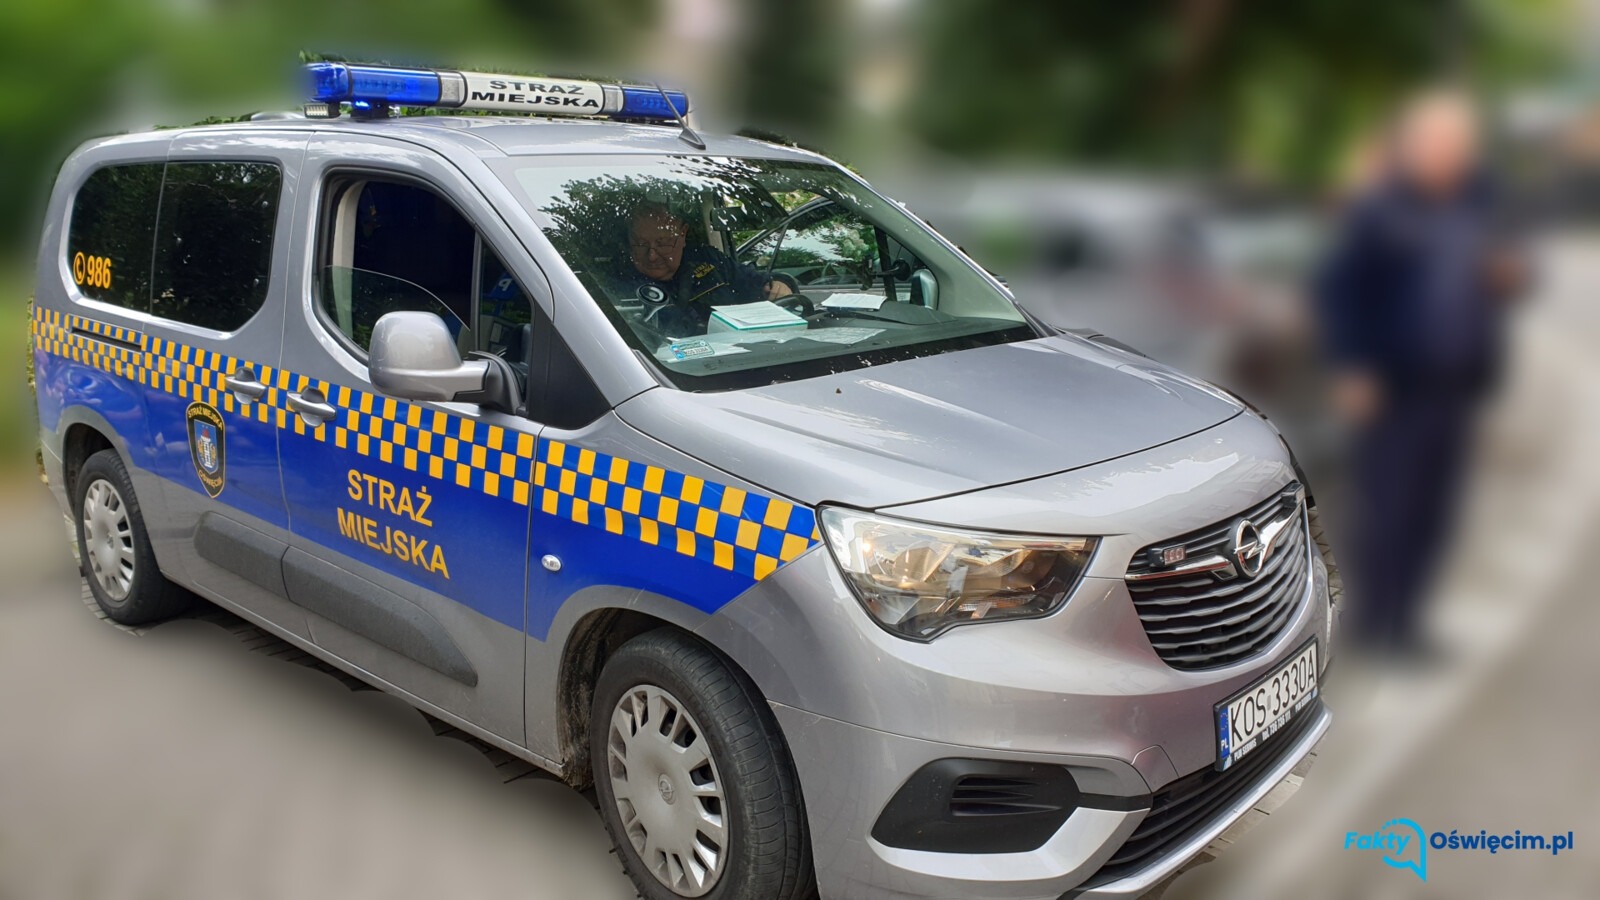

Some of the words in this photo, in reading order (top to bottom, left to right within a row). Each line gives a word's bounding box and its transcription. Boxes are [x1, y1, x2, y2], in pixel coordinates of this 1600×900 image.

[471, 91, 599, 108] MIEJSKA
[490, 80, 584, 95] STRAŻ
[86, 255, 112, 289] 986
[187, 405, 202, 419] STRAŻ
[347, 468, 433, 527] STRAŻ
[336, 507, 450, 580] MIEJSKA
[1231, 688, 1266, 747] KOS
[1272, 650, 1315, 715] 3330A
[1220, 738, 1229, 752] PL
